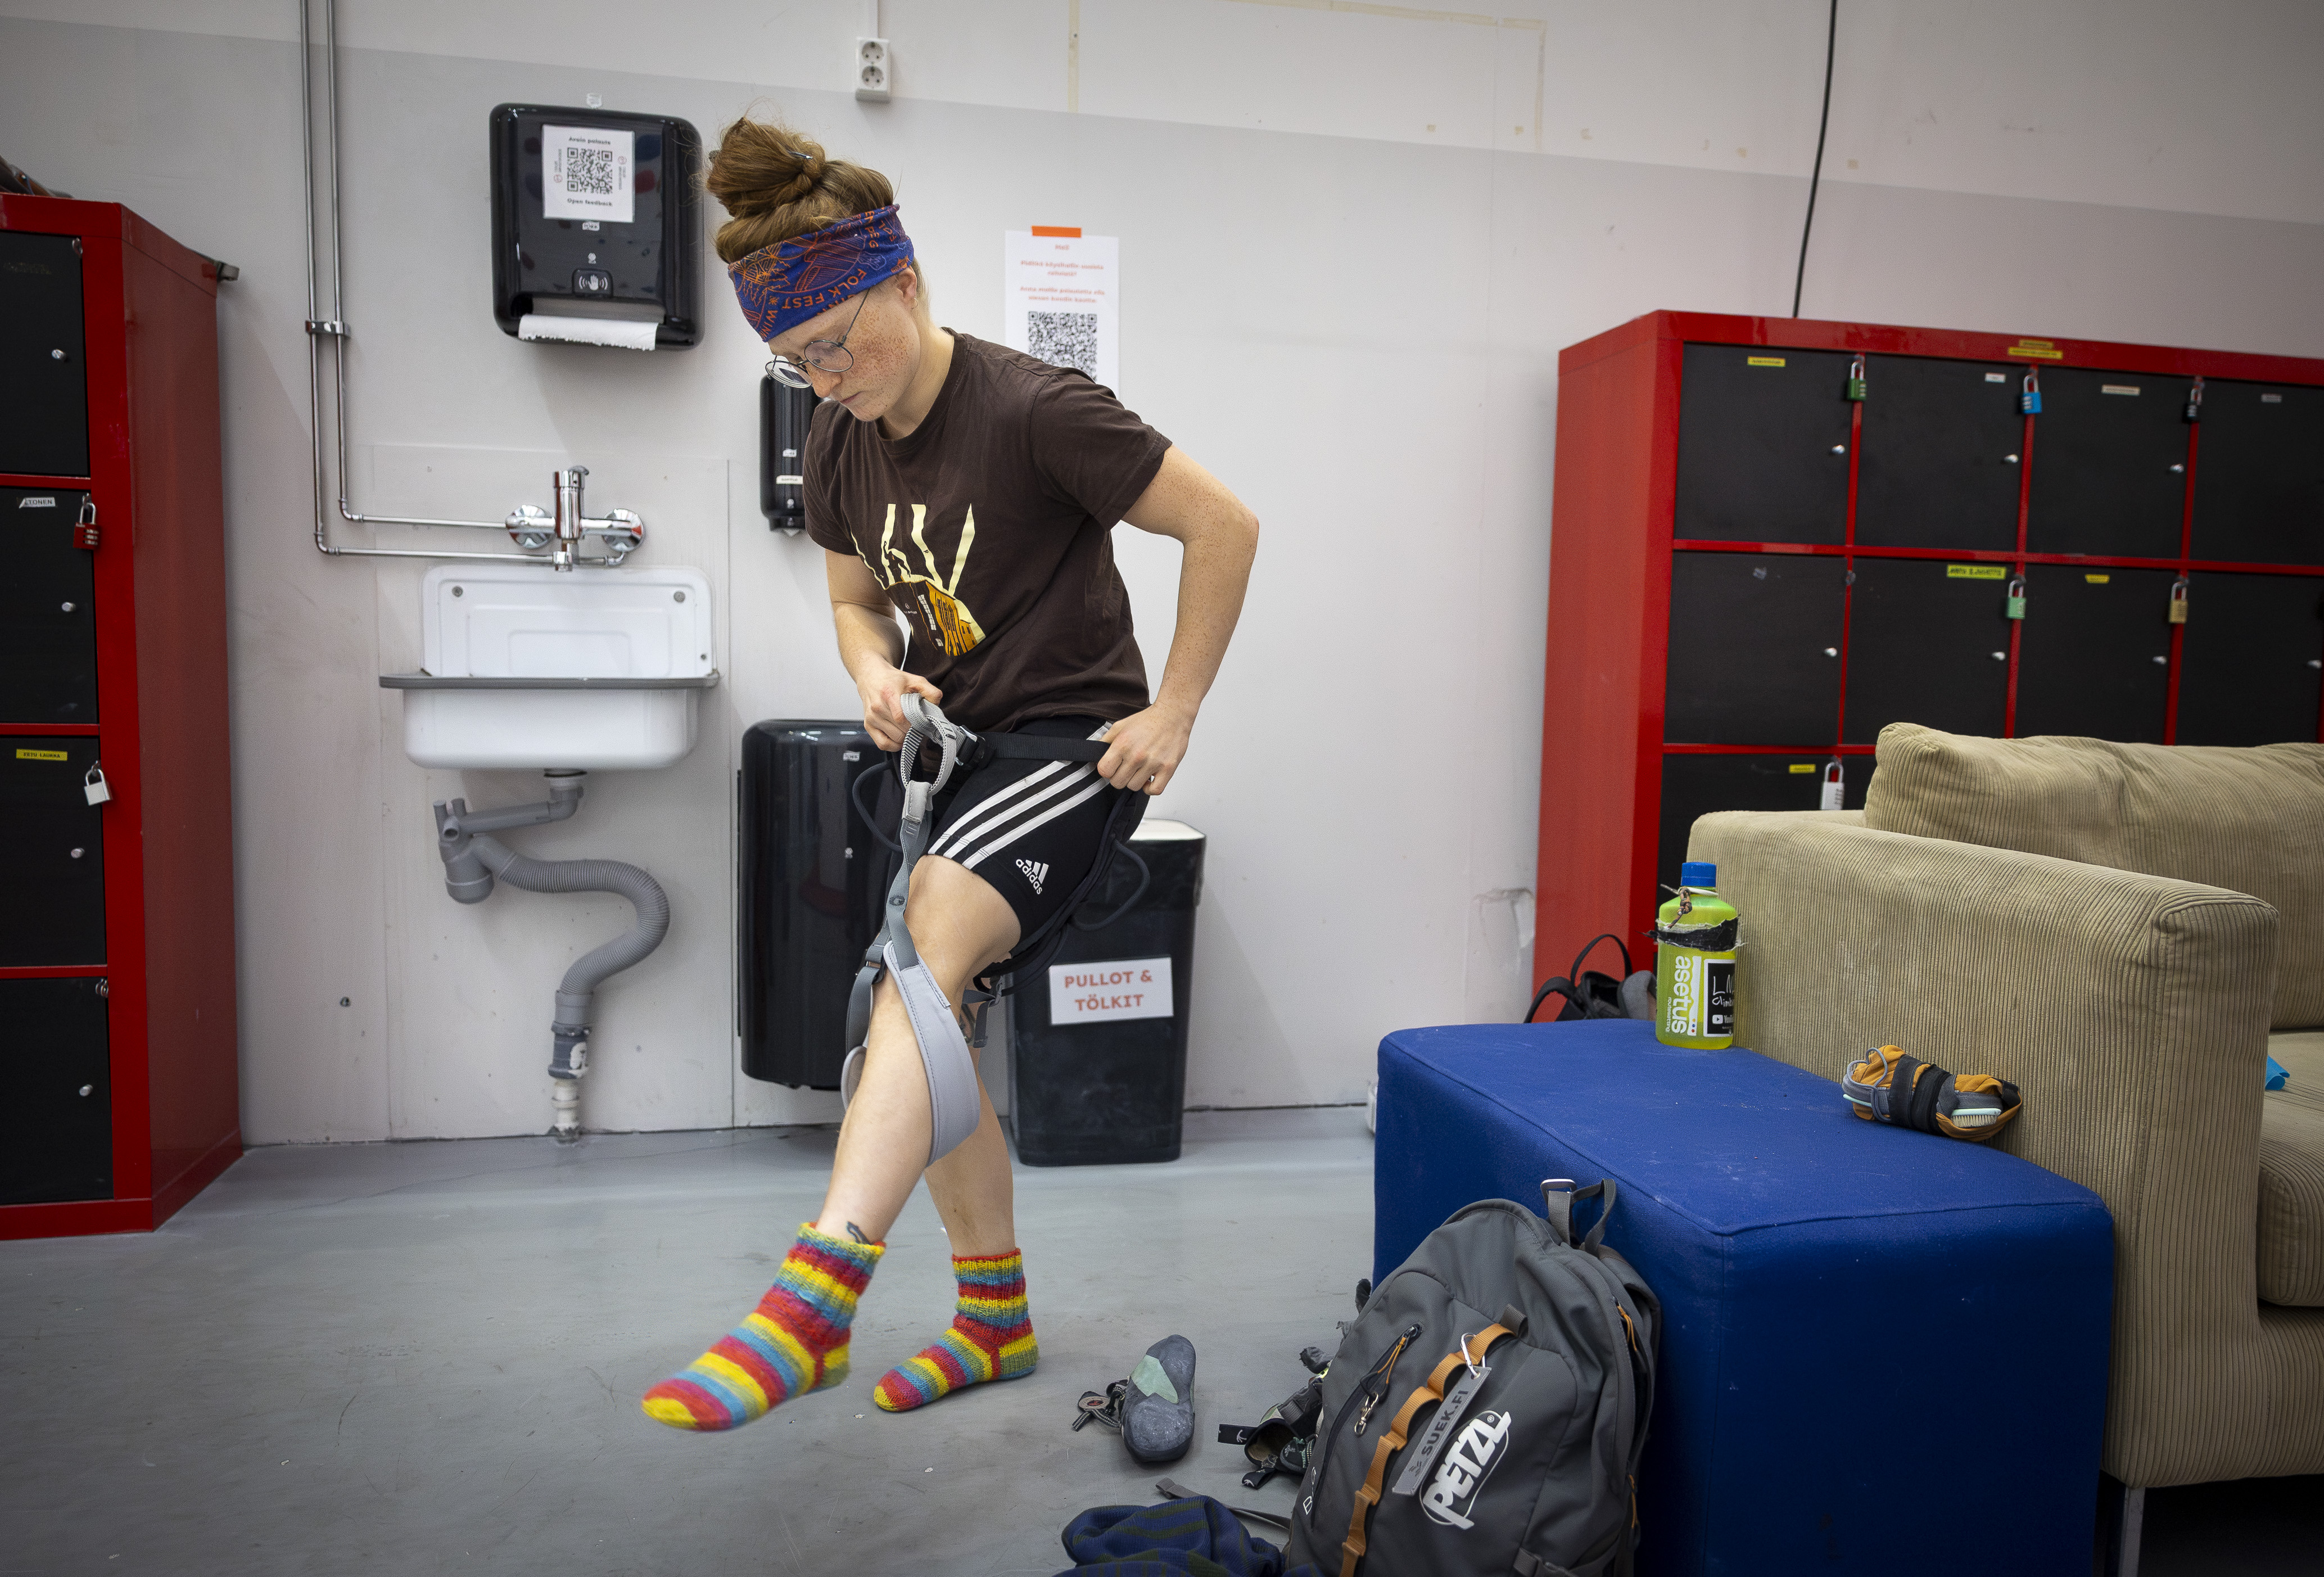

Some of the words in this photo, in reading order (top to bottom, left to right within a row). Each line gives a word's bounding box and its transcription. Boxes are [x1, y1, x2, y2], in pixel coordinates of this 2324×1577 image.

[828, 269, 867, 297] FOLK
[781, 292, 825, 309] FEST
[1016, 859, 1042, 894] adidas
[1064, 971, 1134, 988] PULLOT
[1140, 969, 1152, 983] &
[1075, 994, 1144, 1011] TÖLKIT
[1671, 955, 1692, 1034] asetus
[1421, 1389, 1468, 1456] SUEK.FI
[1423, 1411, 1512, 1530] PETZL
